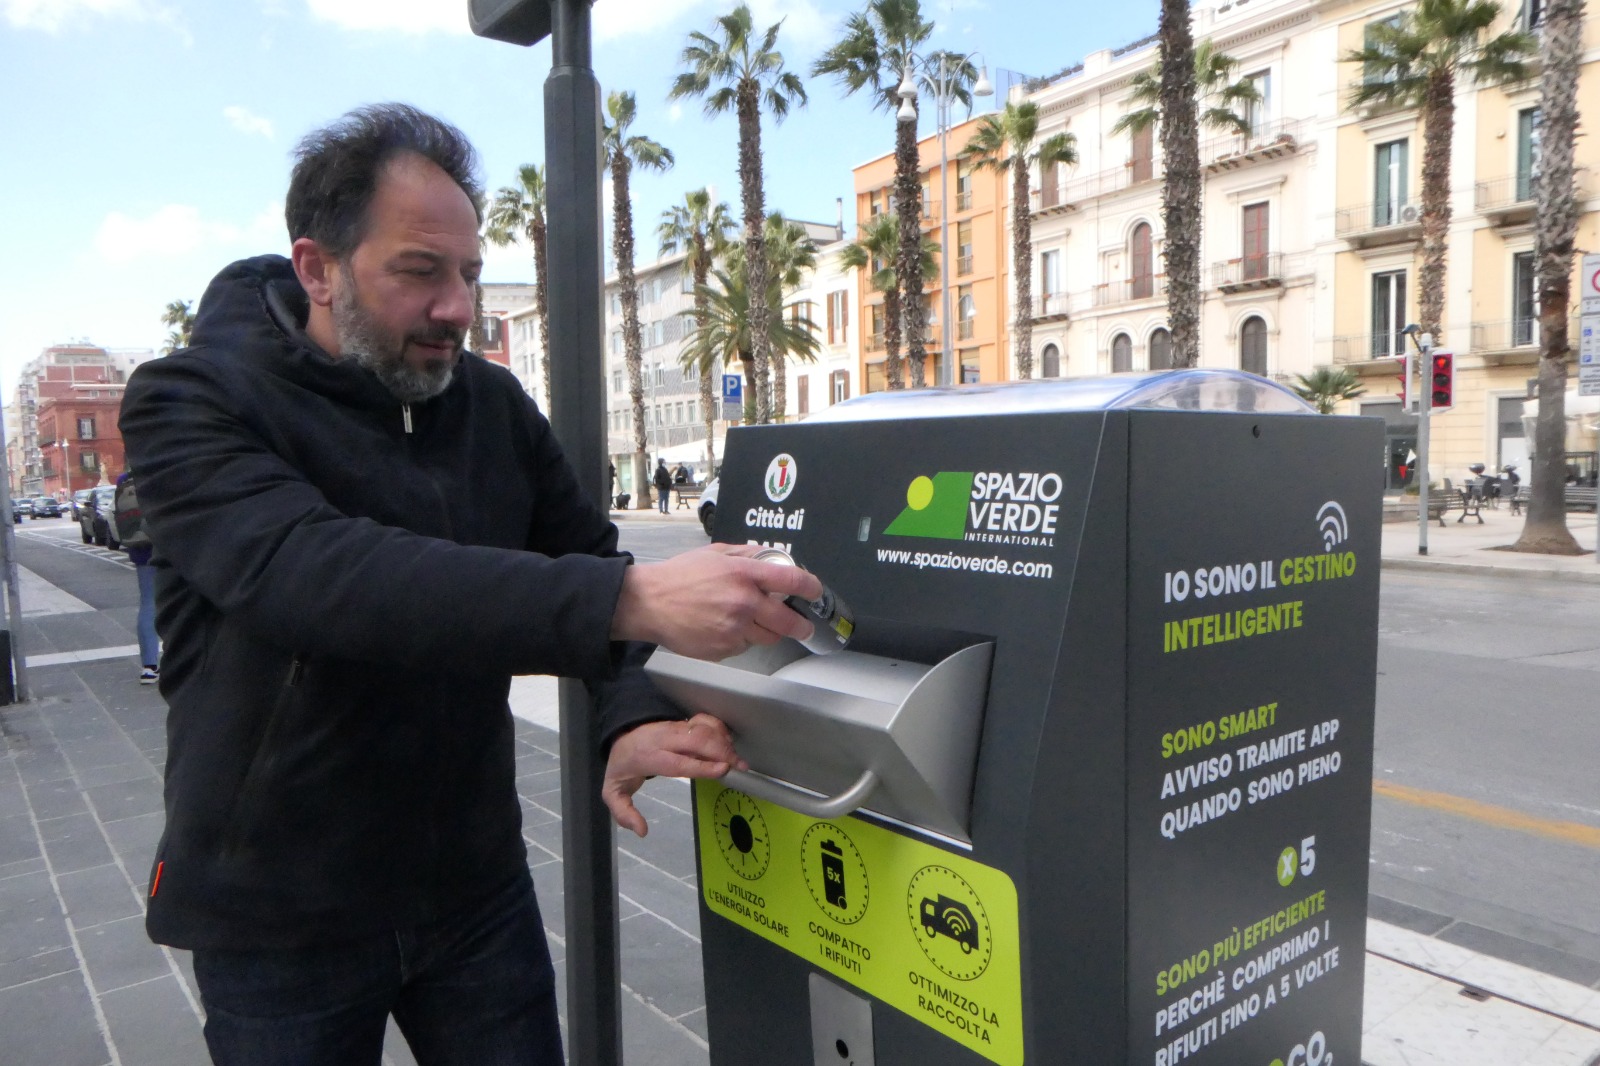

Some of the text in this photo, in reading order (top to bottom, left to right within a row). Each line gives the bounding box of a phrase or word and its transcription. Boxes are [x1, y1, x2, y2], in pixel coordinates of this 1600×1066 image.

[726, 376, 738, 395] P
[971, 472, 1063, 502] SPAZIO
[745, 506, 805, 530] Città di
[969, 502, 1060, 534] VERDE
[964, 532, 1055, 547] INTERNATIONAL
[877, 549, 1053, 579] www.spazioverde.com
[1164, 551, 1356, 603] IO SONO IL CESTINO
[1163, 601, 1303, 653] INTELLIGENTE
[1161, 702, 1278, 759] SONO SMART
[1160, 719, 1340, 800] AVVISO TRAMITE APP
[1160, 751, 1342, 840] QUANDO SONO PIENO
[827, 866, 841, 884] 5x
[1300, 835, 1316, 877] 5
[727, 881, 766, 909] UTILIZZO
[753, 912, 790, 938] SOLARE
[808, 921, 871, 961] COMPATTO
[1156, 889, 1326, 996] SONO PIÙ EFFICIENTE
[819, 943, 862, 975] I RIFIUTI
[1155, 919, 1330, 1037] PERCHÈ COMPRIMO I
[908, 971, 1000, 1028] OTTIMIZZO LA
[918, 994, 991, 1045] RACCOLTA
[1155, 946, 1340, 1066] RIFIUTI FINO A 5 VOLTE
